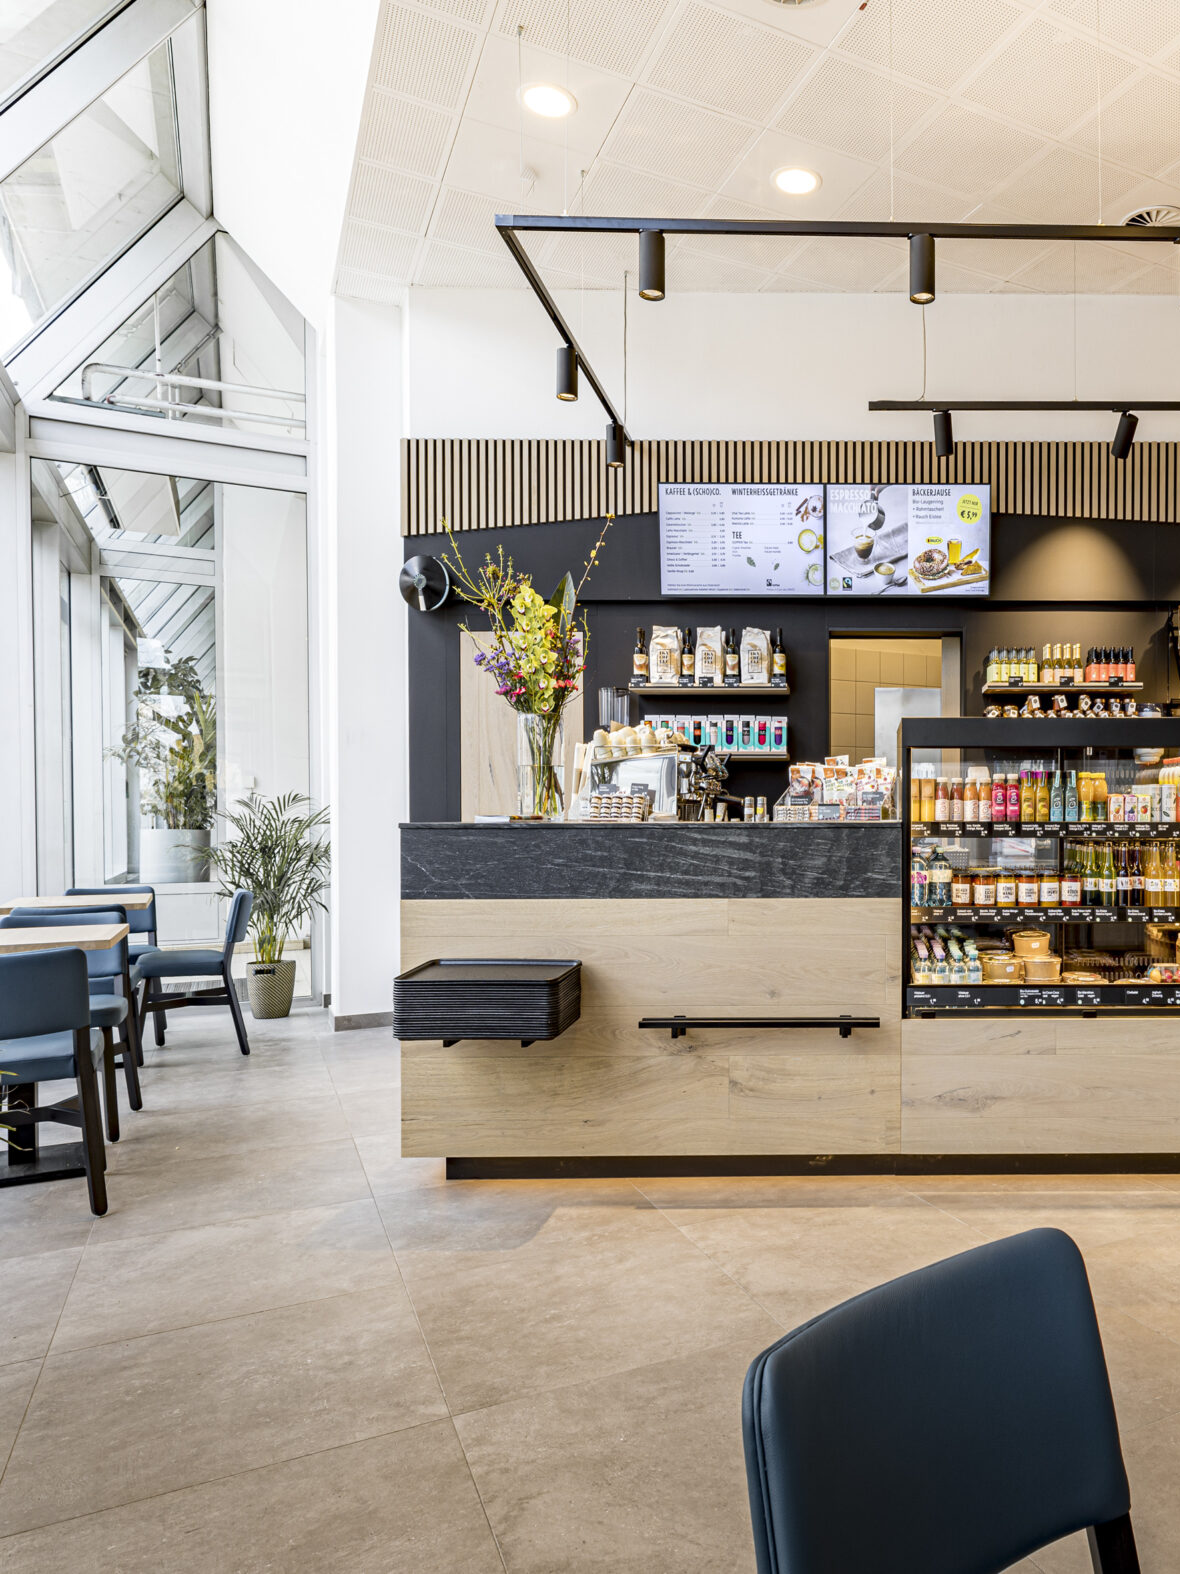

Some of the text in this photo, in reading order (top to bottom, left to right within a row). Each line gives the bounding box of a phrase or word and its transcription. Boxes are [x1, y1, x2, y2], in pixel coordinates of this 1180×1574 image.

[665, 488, 722, 496] KAFFEE & (SCHO)CO.
[731, 487, 798, 496] WINTERHEISSGETRÄNKE
[830, 489, 871, 500] ESPRESSO
[912, 488, 951, 496] BÄCKERJAUSE
[830, 502, 877, 513] MACCHIATO
[961, 510, 977, 520] € 5,99
[732, 531, 742, 539] TEE
